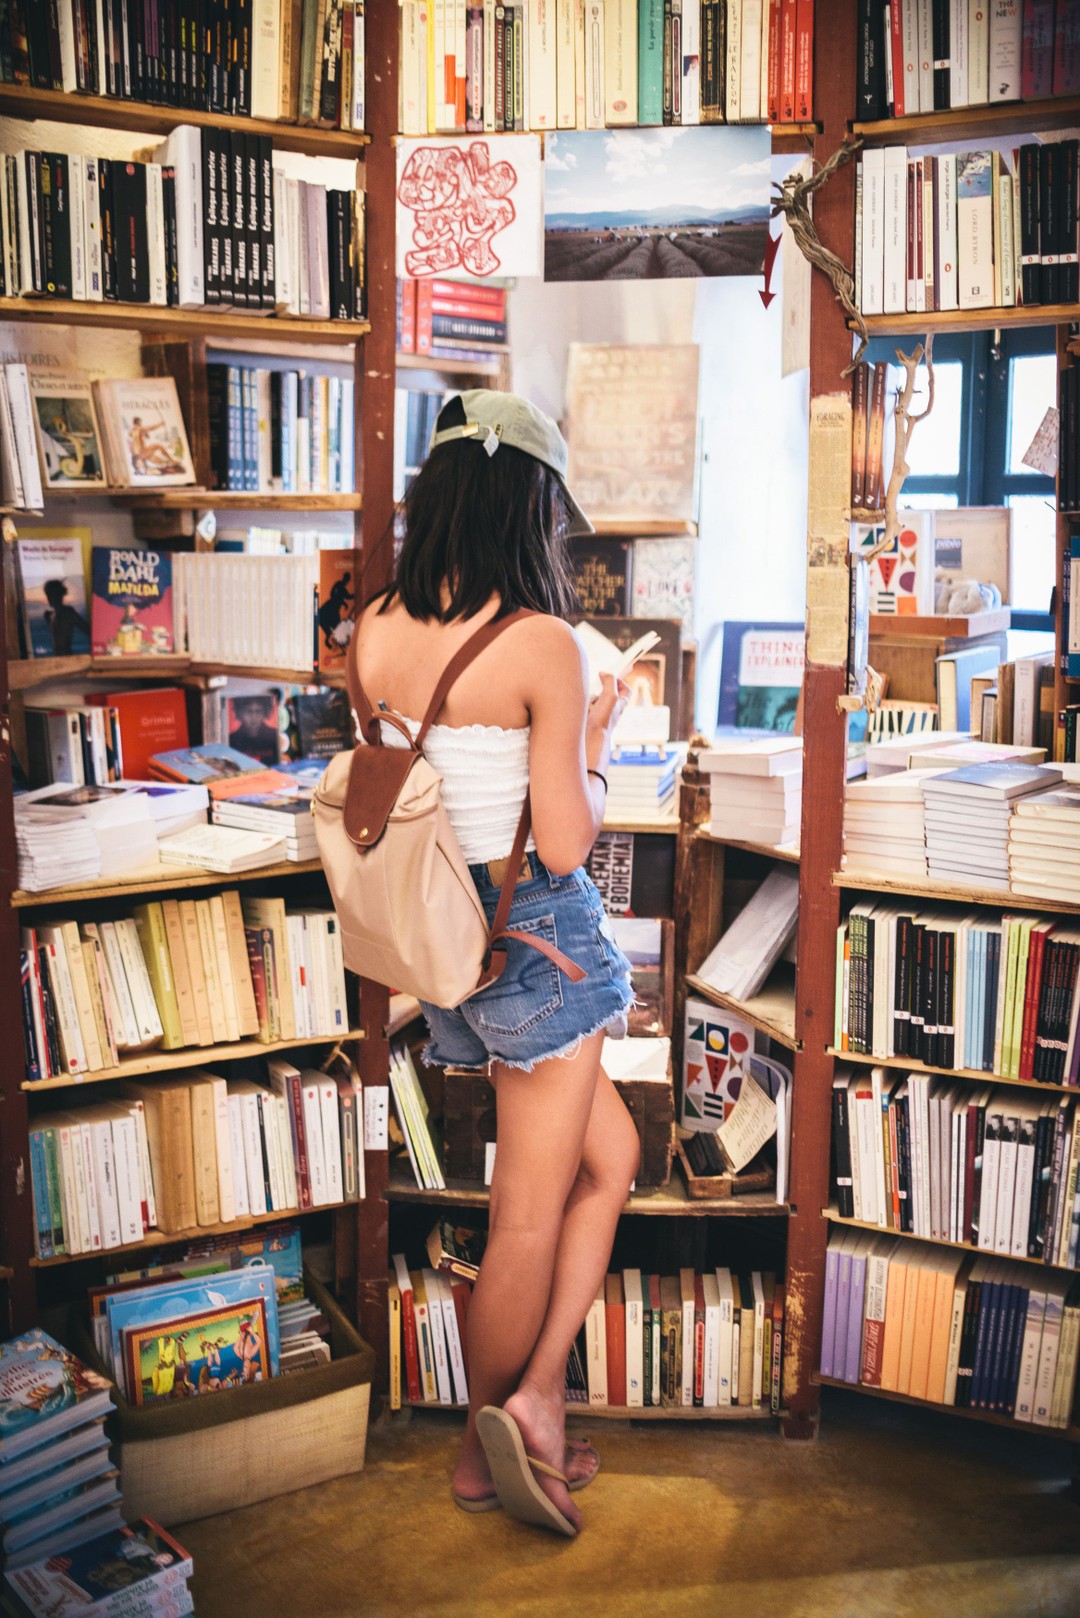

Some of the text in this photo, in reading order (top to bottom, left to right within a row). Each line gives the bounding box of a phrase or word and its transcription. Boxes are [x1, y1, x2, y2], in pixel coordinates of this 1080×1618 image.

[996, 8, 1016, 18] NEW
[208, 150, 216, 189] meurtrier
[249, 158, 257, 196] meurtrier
[263, 159, 271, 196] meurtrier
[207, 190, 217, 225] Épilogue
[220, 191, 229, 226] Épilogue
[234, 154, 246, 279] MARKARIS Épilogue meurtrier
[248, 196, 257, 231] Épilogue
[262, 197, 271, 232] Épilogue
[971, 208, 979, 265] LORD BYRON
[224, 238, 232, 275] MARKARIS
[109, 550, 160, 567] ROALD
[109, 566, 160, 583] DAHL
[108, 581, 159, 596] MATILDA
[140, 713, 176, 727] Grimal
[610, 842, 630, 904] BOHEMIA
[986, 1142, 996, 1190] DYLAN THOMAS
[1001, 1143, 1011, 1192] DYLAN THOMAS
[1019, 1146, 1029, 1195] DYLAN THOMAS
[1023, 1364, 1032, 1386] YEATS
[1042, 1367, 1050, 1389] YEATS
